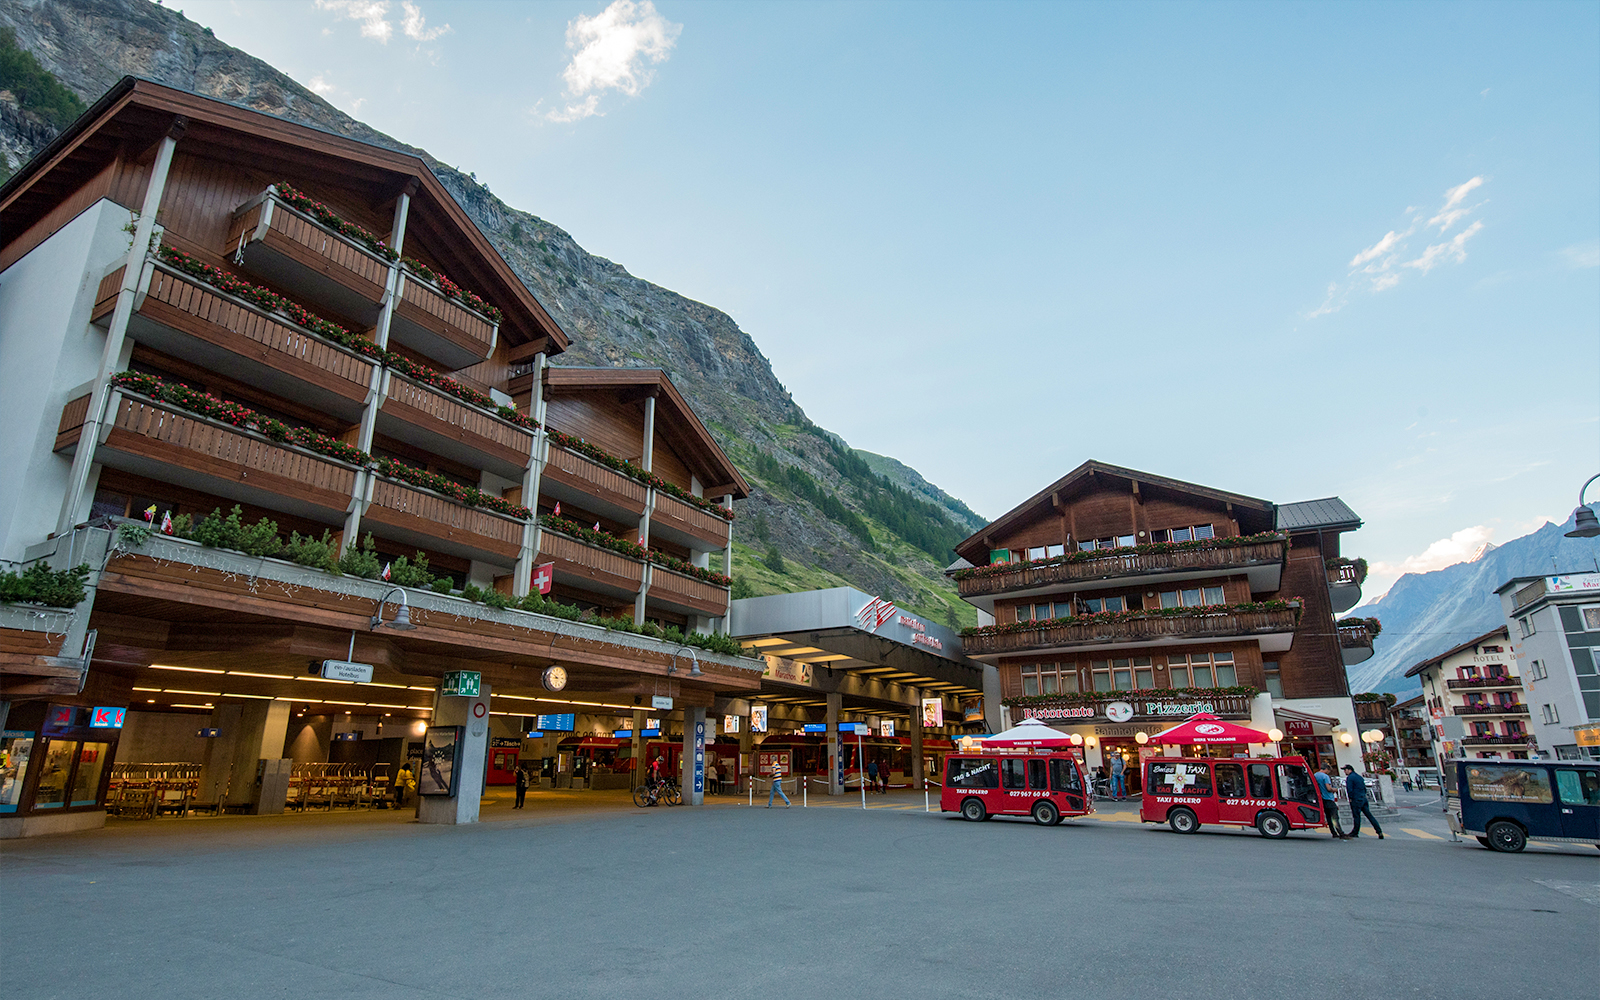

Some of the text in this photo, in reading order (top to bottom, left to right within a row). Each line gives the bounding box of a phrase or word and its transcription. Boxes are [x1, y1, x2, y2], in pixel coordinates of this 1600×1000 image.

[338, 671, 360, 679] Hotelbus
[775, 669, 797, 681] Marathon
[1023, 706, 1094, 719] Ristorante
[1146, 702, 1215, 715] Pizzeria
[1289, 721, 1309, 729] ATM
[953, 773, 964, 782] TAG
[971, 763, 991, 776] NACHT
[1186, 766, 1206, 774] TAXI
